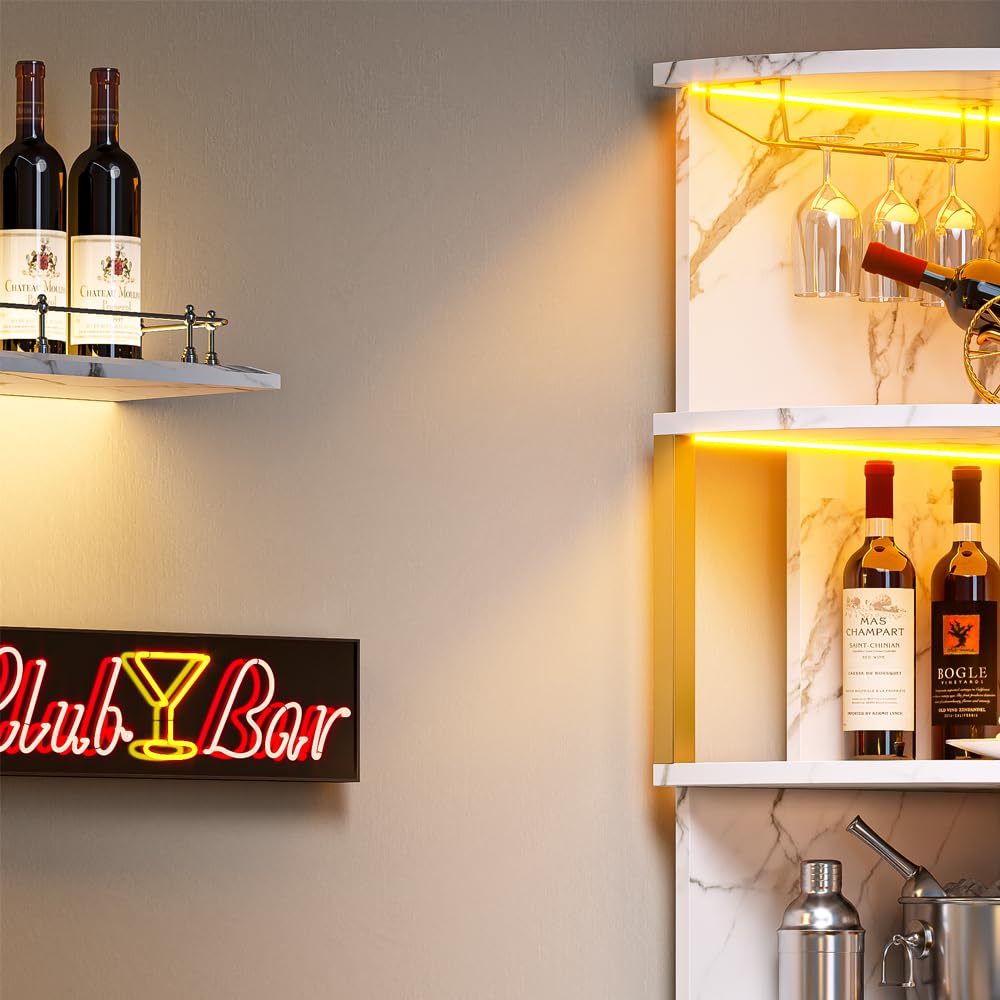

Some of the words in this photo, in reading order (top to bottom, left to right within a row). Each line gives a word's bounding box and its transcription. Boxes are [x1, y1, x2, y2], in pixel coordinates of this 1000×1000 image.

[860, 616, 888, 626] MAS
[845, 627, 905, 637] CHAMPART
[937, 666, 988, 680] BOGLE
[202, 657, 352, 761] Bar
